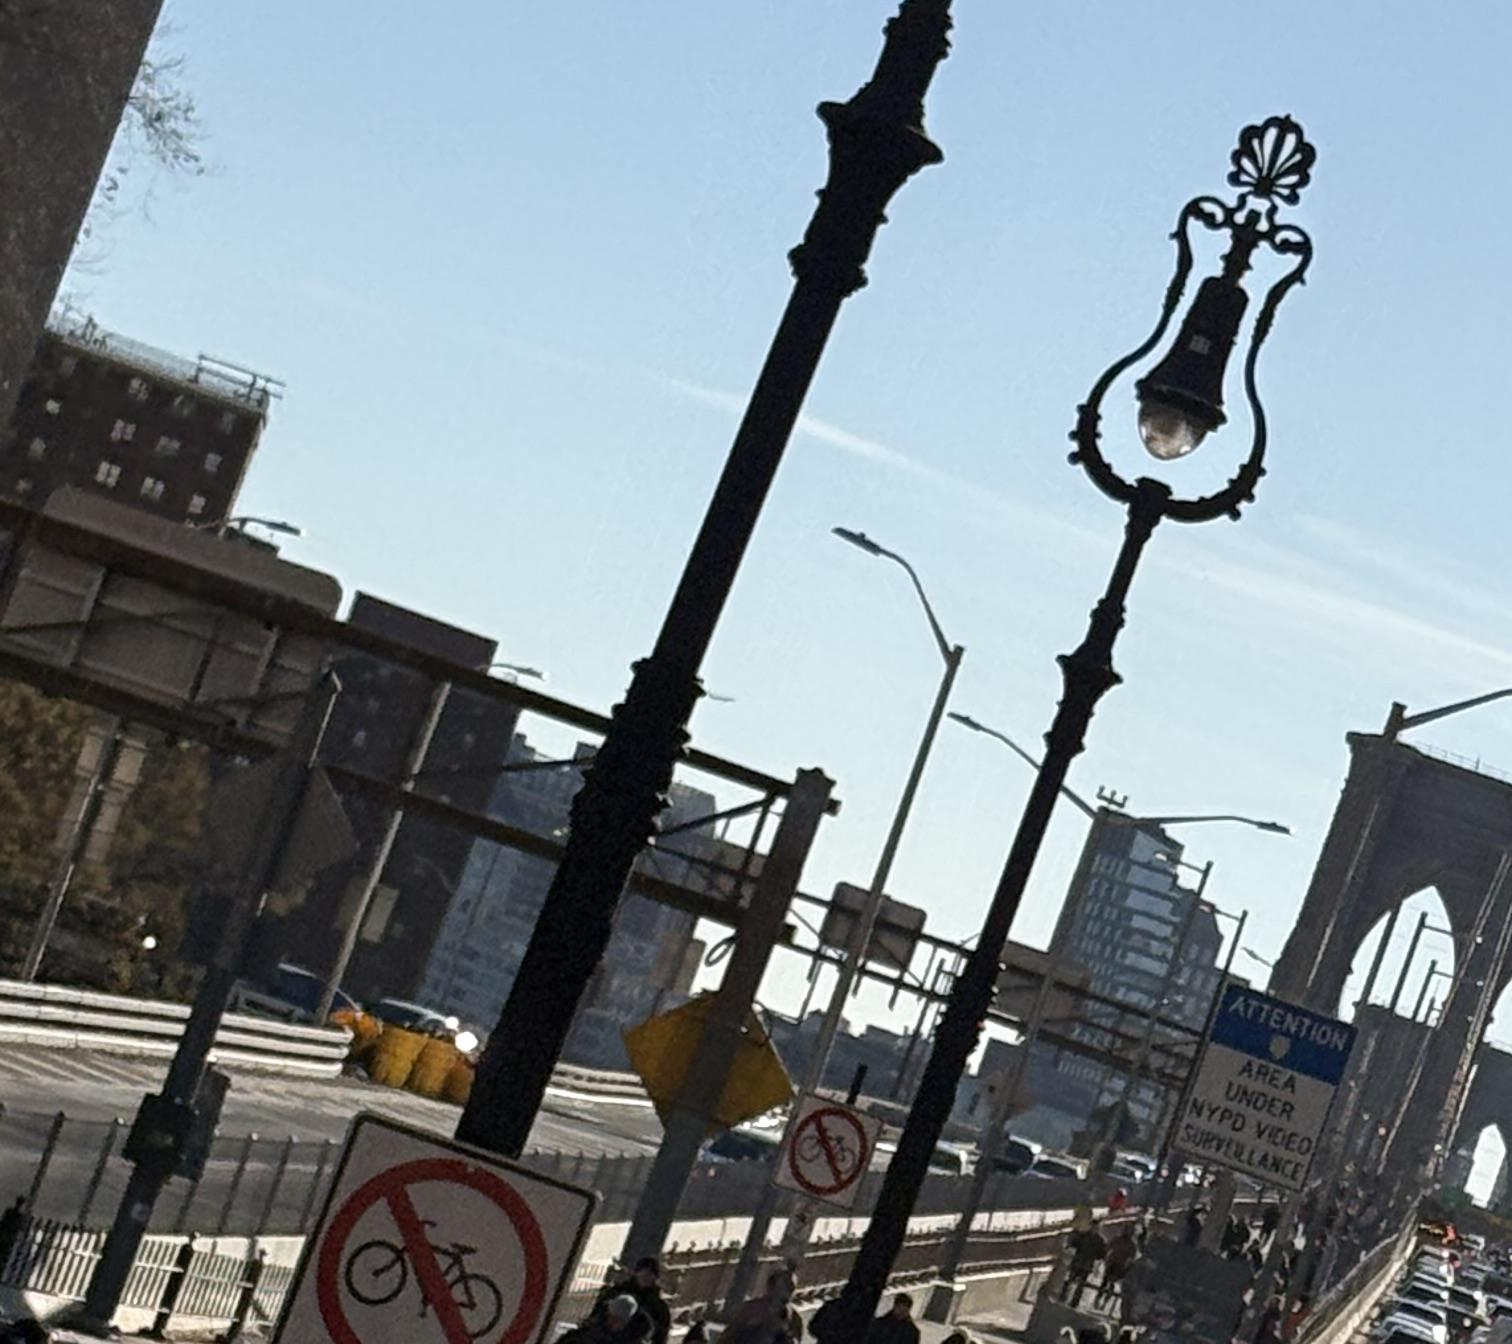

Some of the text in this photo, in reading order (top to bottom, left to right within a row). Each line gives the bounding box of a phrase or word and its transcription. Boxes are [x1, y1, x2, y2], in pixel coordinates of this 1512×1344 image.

[1228, 996, 1348, 1051] ATTENTION
[1225, 1082, 1295, 1121] UNDER
[1239, 1060, 1296, 1094] AREA
[1180, 1124, 1304, 1181] SURVEILLANCE
[1190, 1098, 1313, 1156] NYPD VIDEO
